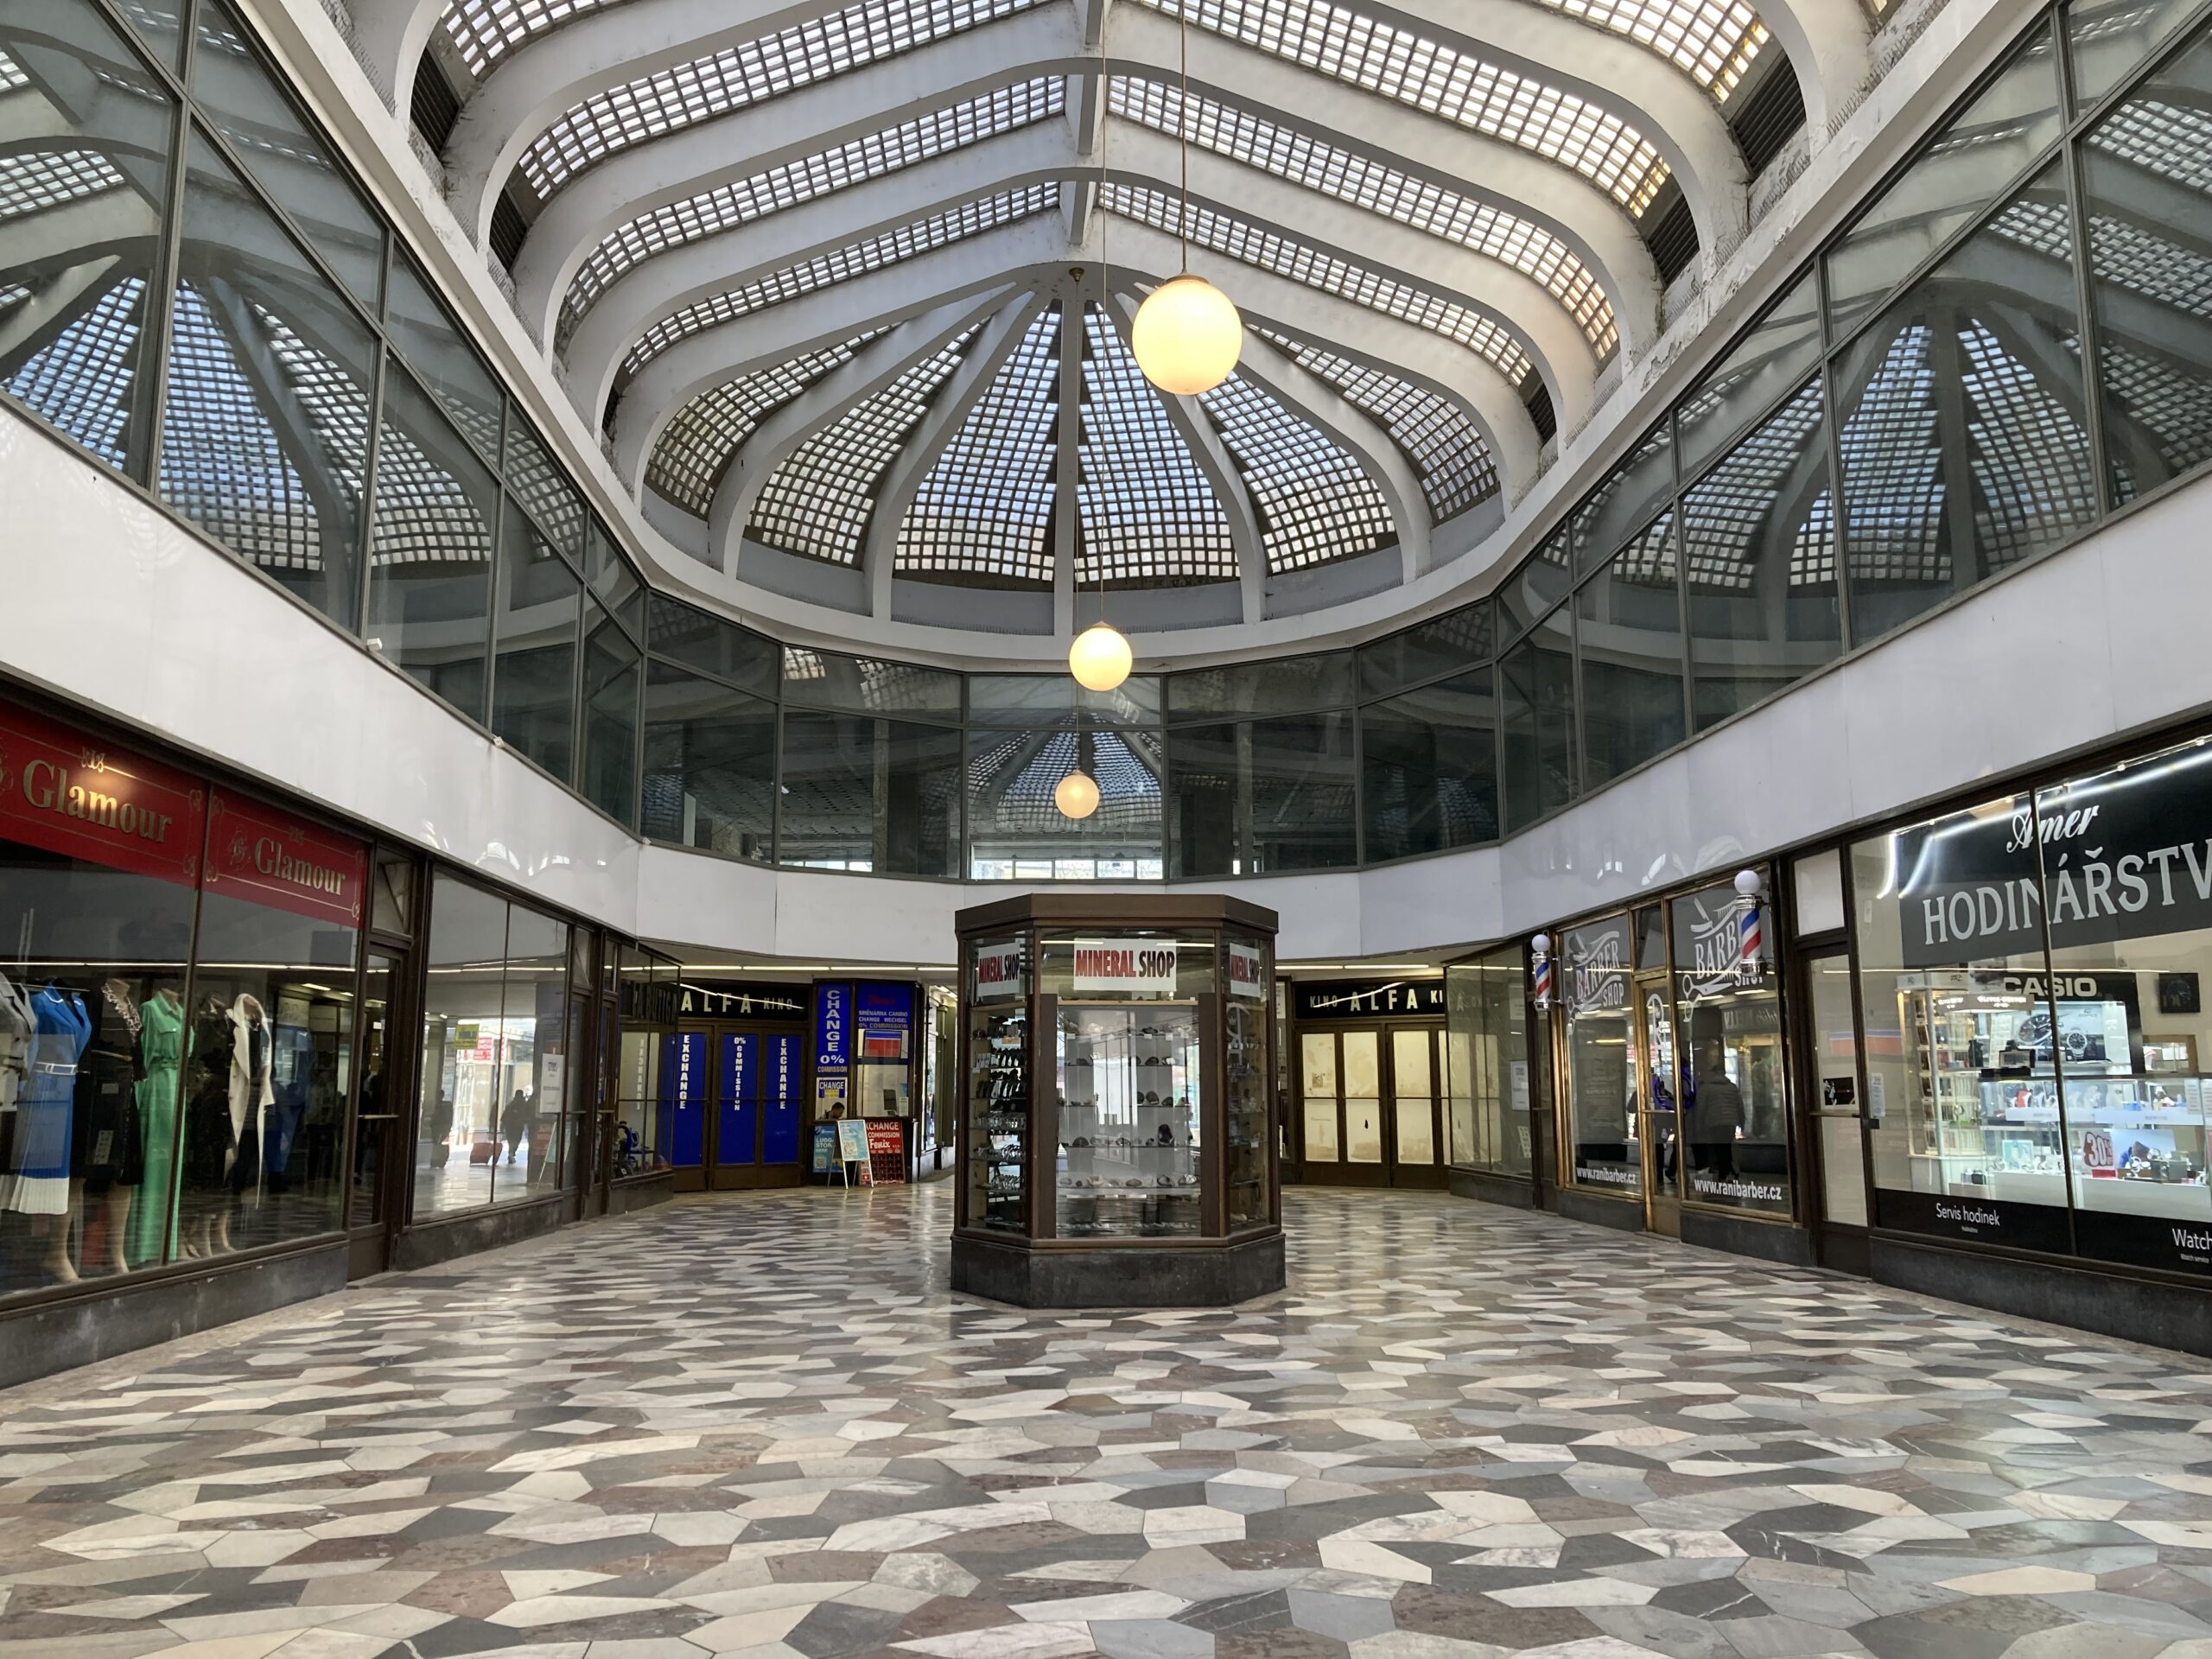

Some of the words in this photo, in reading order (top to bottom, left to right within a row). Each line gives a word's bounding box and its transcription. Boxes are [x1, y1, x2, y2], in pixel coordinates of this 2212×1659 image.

[22, 760, 172, 844] Glamour
[2006, 795, 2100, 854] Amer
[254, 836, 346, 896] Glamour
[978, 957, 1003, 984] MINERAL
[1004, 953, 1020, 981] SHOP
[1074, 950, 1136, 977] MINERAL
[1139, 950, 1175, 978] SHOP
[1230, 955, 1249, 982] MINERAL
[1576, 941, 1620, 1000] BARBER
[1351, 988, 1418, 1012] ALFA
[1603, 983, 1624, 1007] SHOP
[2004, 977, 2097, 997] CASIO
[681, 991, 751, 1014] ALFA
[764, 997, 792, 1010] KINO
[826, 990, 841, 1052] CHANGE
[679, 1035, 690, 1109] EXCHANGE
[820, 1055, 845, 1064] 0%
[868, 1139, 891, 1149] Fenix
[1576, 1166, 1637, 1185] www.ranibarber.cz
[1694, 1179, 1782, 1201] www.ranibarber.cz
[1936, 1202, 1961, 1221] Servis
[1963, 1205, 2000, 1227] hodinek
